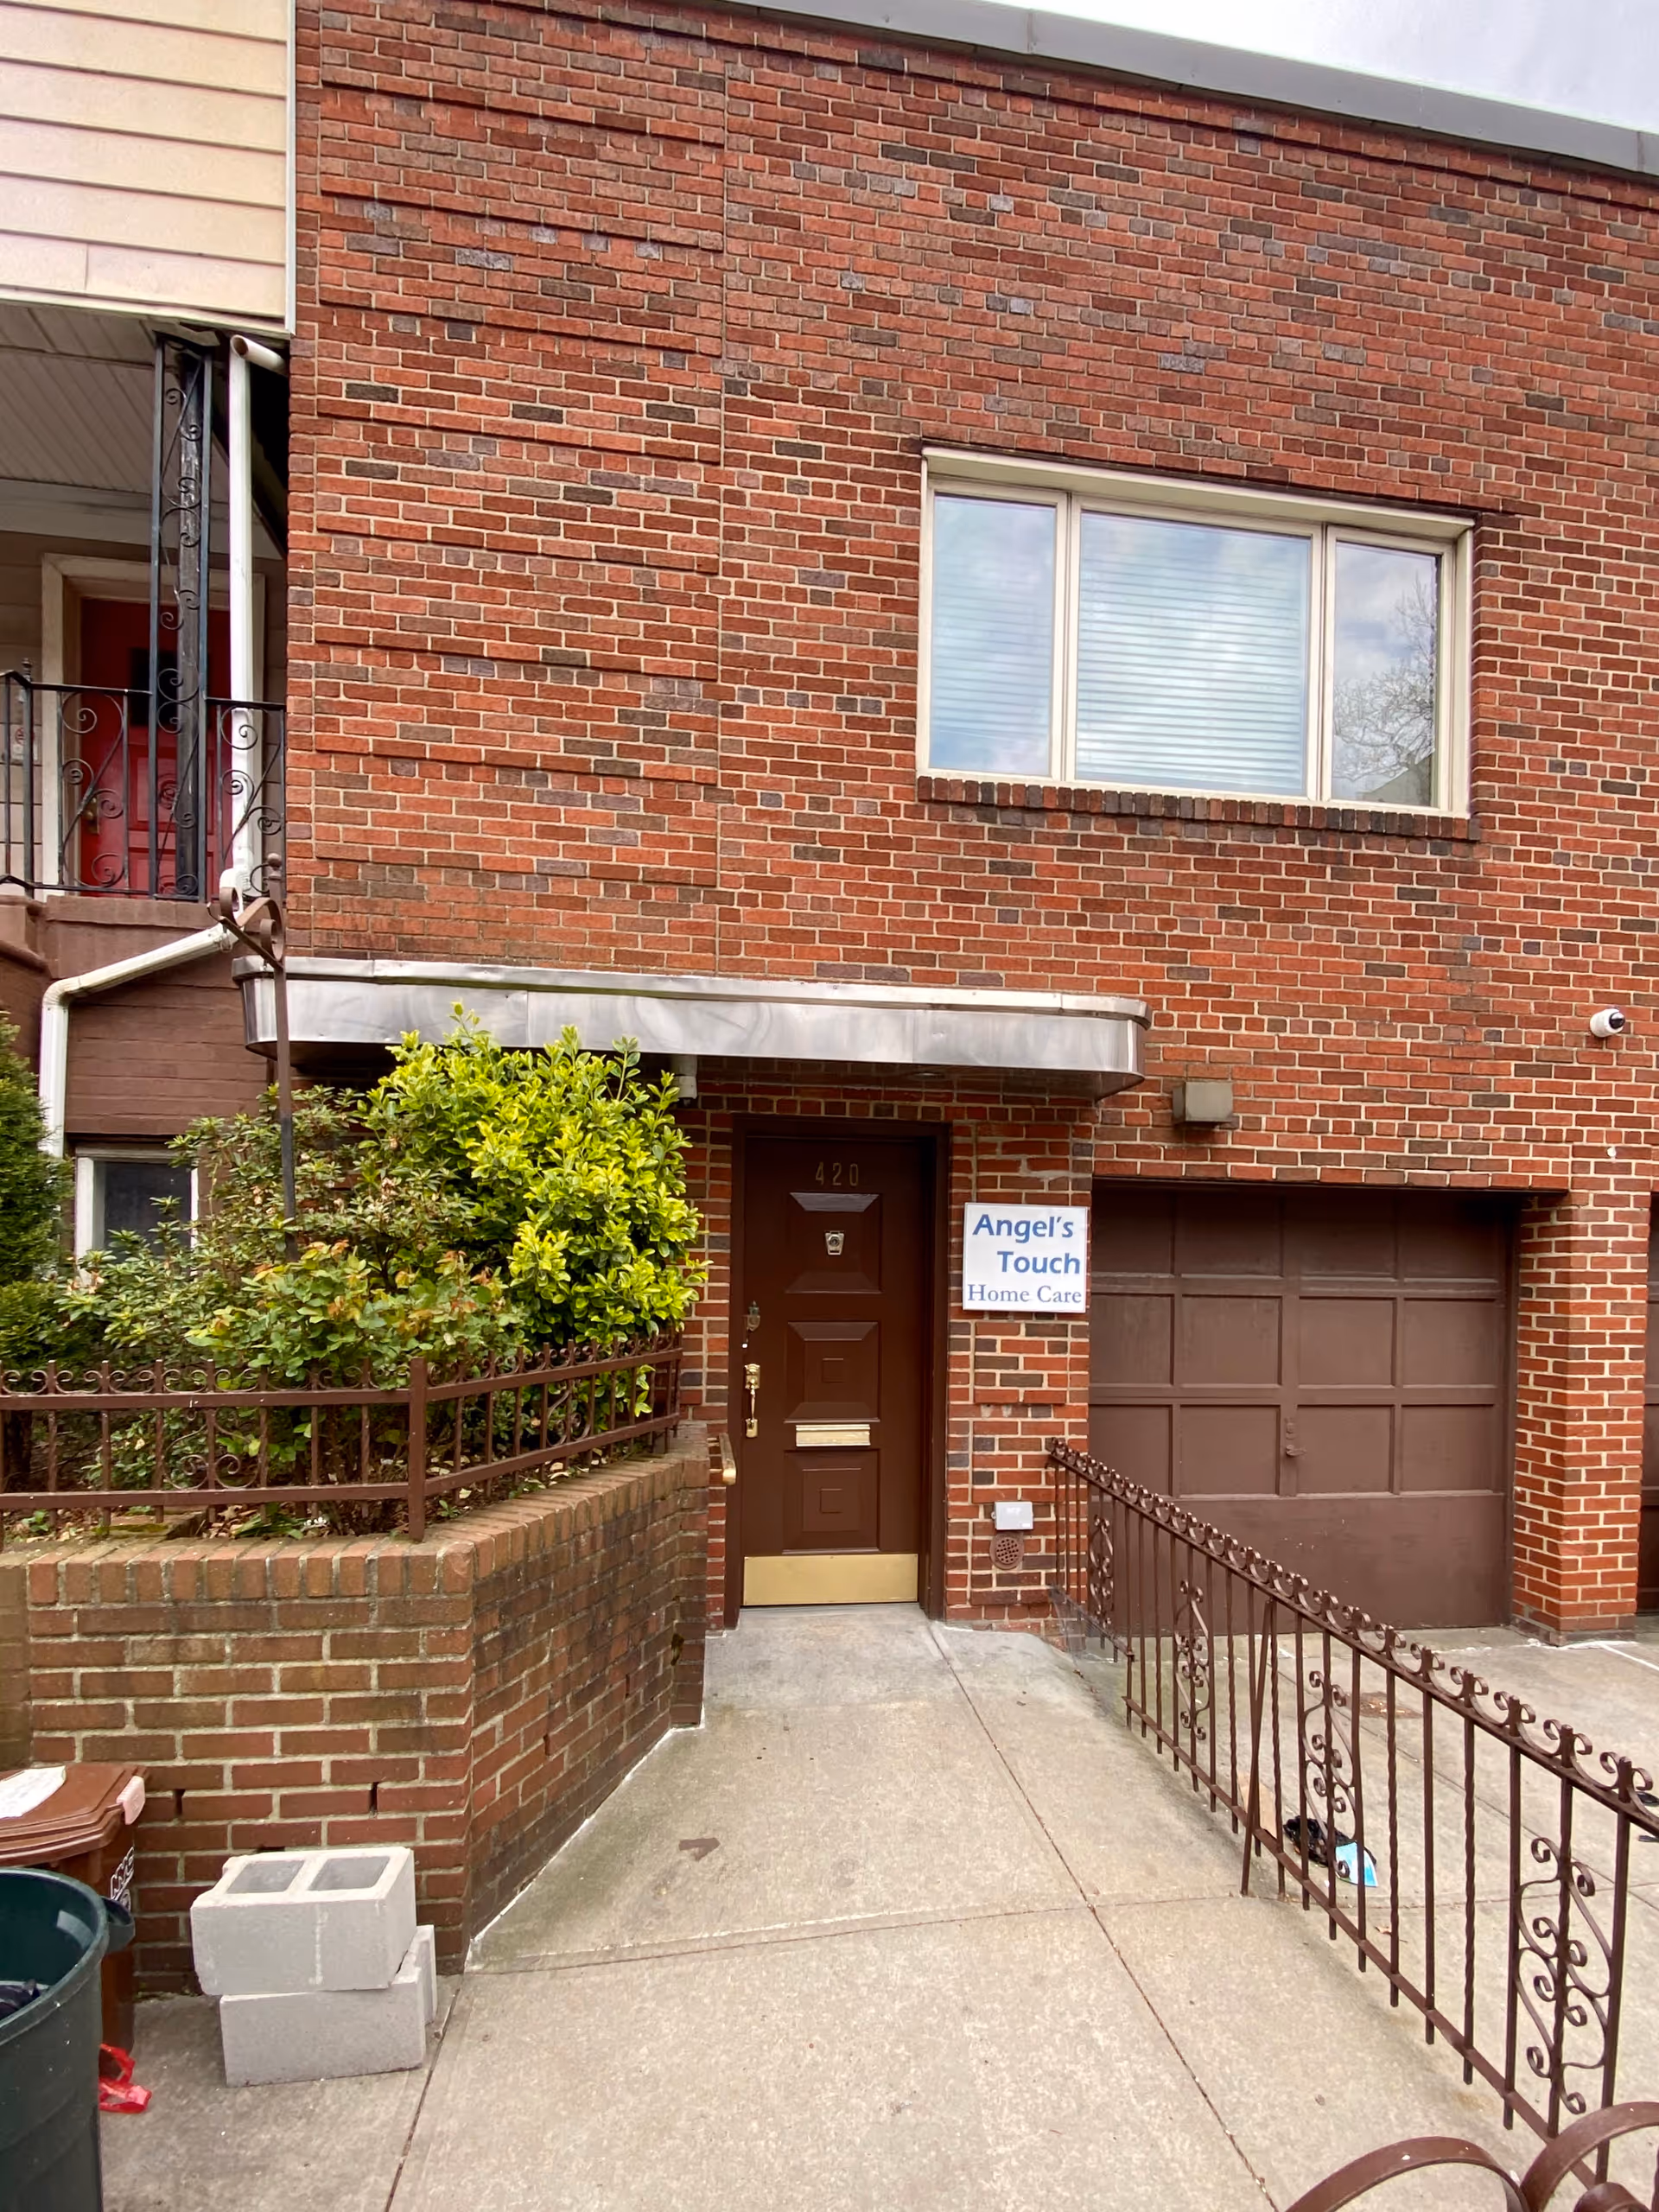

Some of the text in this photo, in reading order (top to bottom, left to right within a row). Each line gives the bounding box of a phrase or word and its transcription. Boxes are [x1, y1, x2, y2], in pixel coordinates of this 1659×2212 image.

[815, 1161, 859, 1186] 420
[972, 1213, 1074, 1244] Angel's
[996, 1250, 1081, 1274] Touch
[967, 1283, 1082, 1304] Home Care
